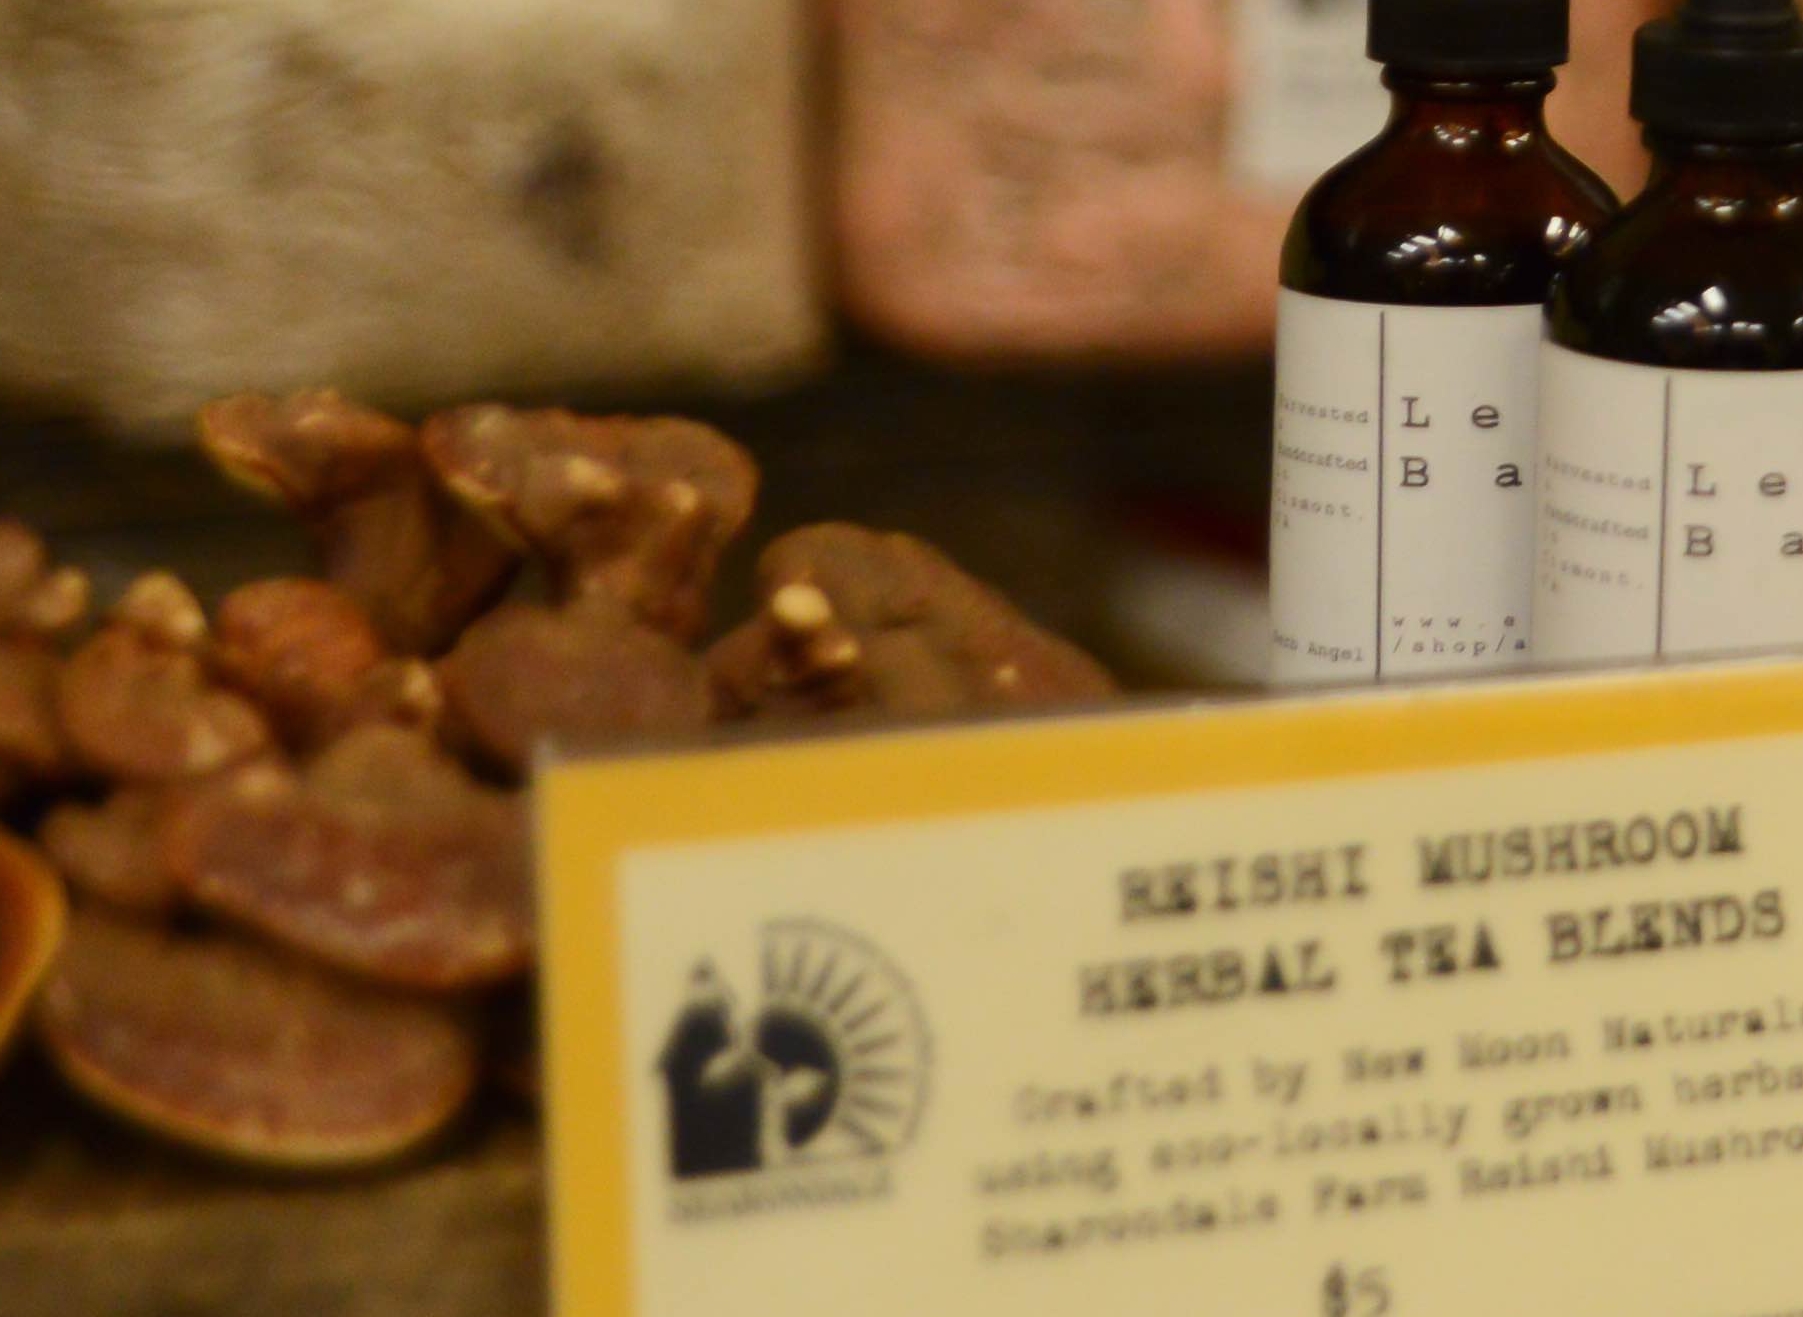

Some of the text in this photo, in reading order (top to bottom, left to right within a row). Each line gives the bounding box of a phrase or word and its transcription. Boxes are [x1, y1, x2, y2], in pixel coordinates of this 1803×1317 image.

[1306, 640, 1364, 663] Angel
[1118, 804, 1747, 923] REISHI MUSHROOM
[1076, 888, 1787, 1017] HERBAL TEA BLENDS
[1252, 1055, 1308, 1106] by
[1500, 1080, 1644, 1140] grown
[1458, 1142, 1617, 1200] Reishi
[1321, 1258, 1393, 1317] $5
